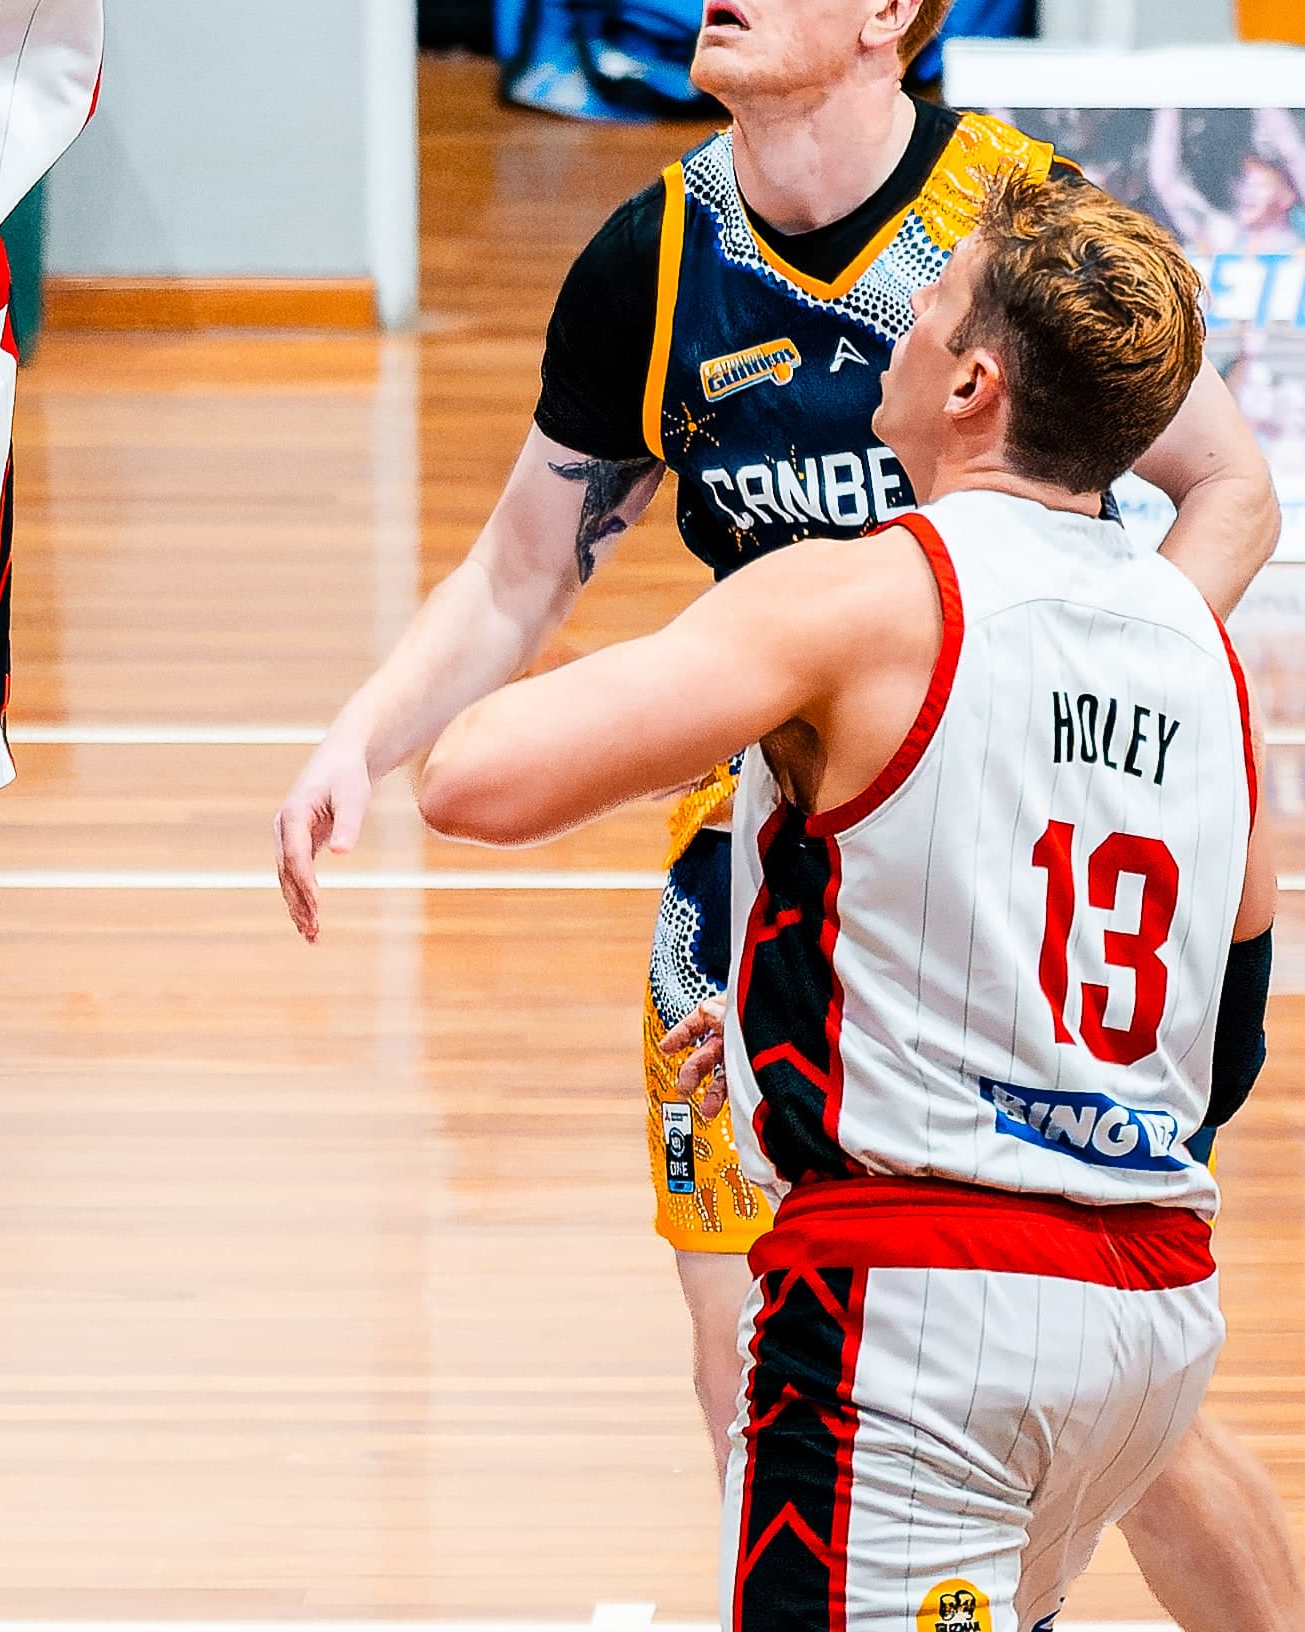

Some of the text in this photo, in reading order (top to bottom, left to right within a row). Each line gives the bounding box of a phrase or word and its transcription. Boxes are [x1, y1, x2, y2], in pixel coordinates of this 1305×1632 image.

[1052, 691, 1180, 786] HOLEY
[1032, 819, 1180, 1067] 13
[991, 1084, 1139, 1158] BING
[669, 1160, 689, 1177] ONE
